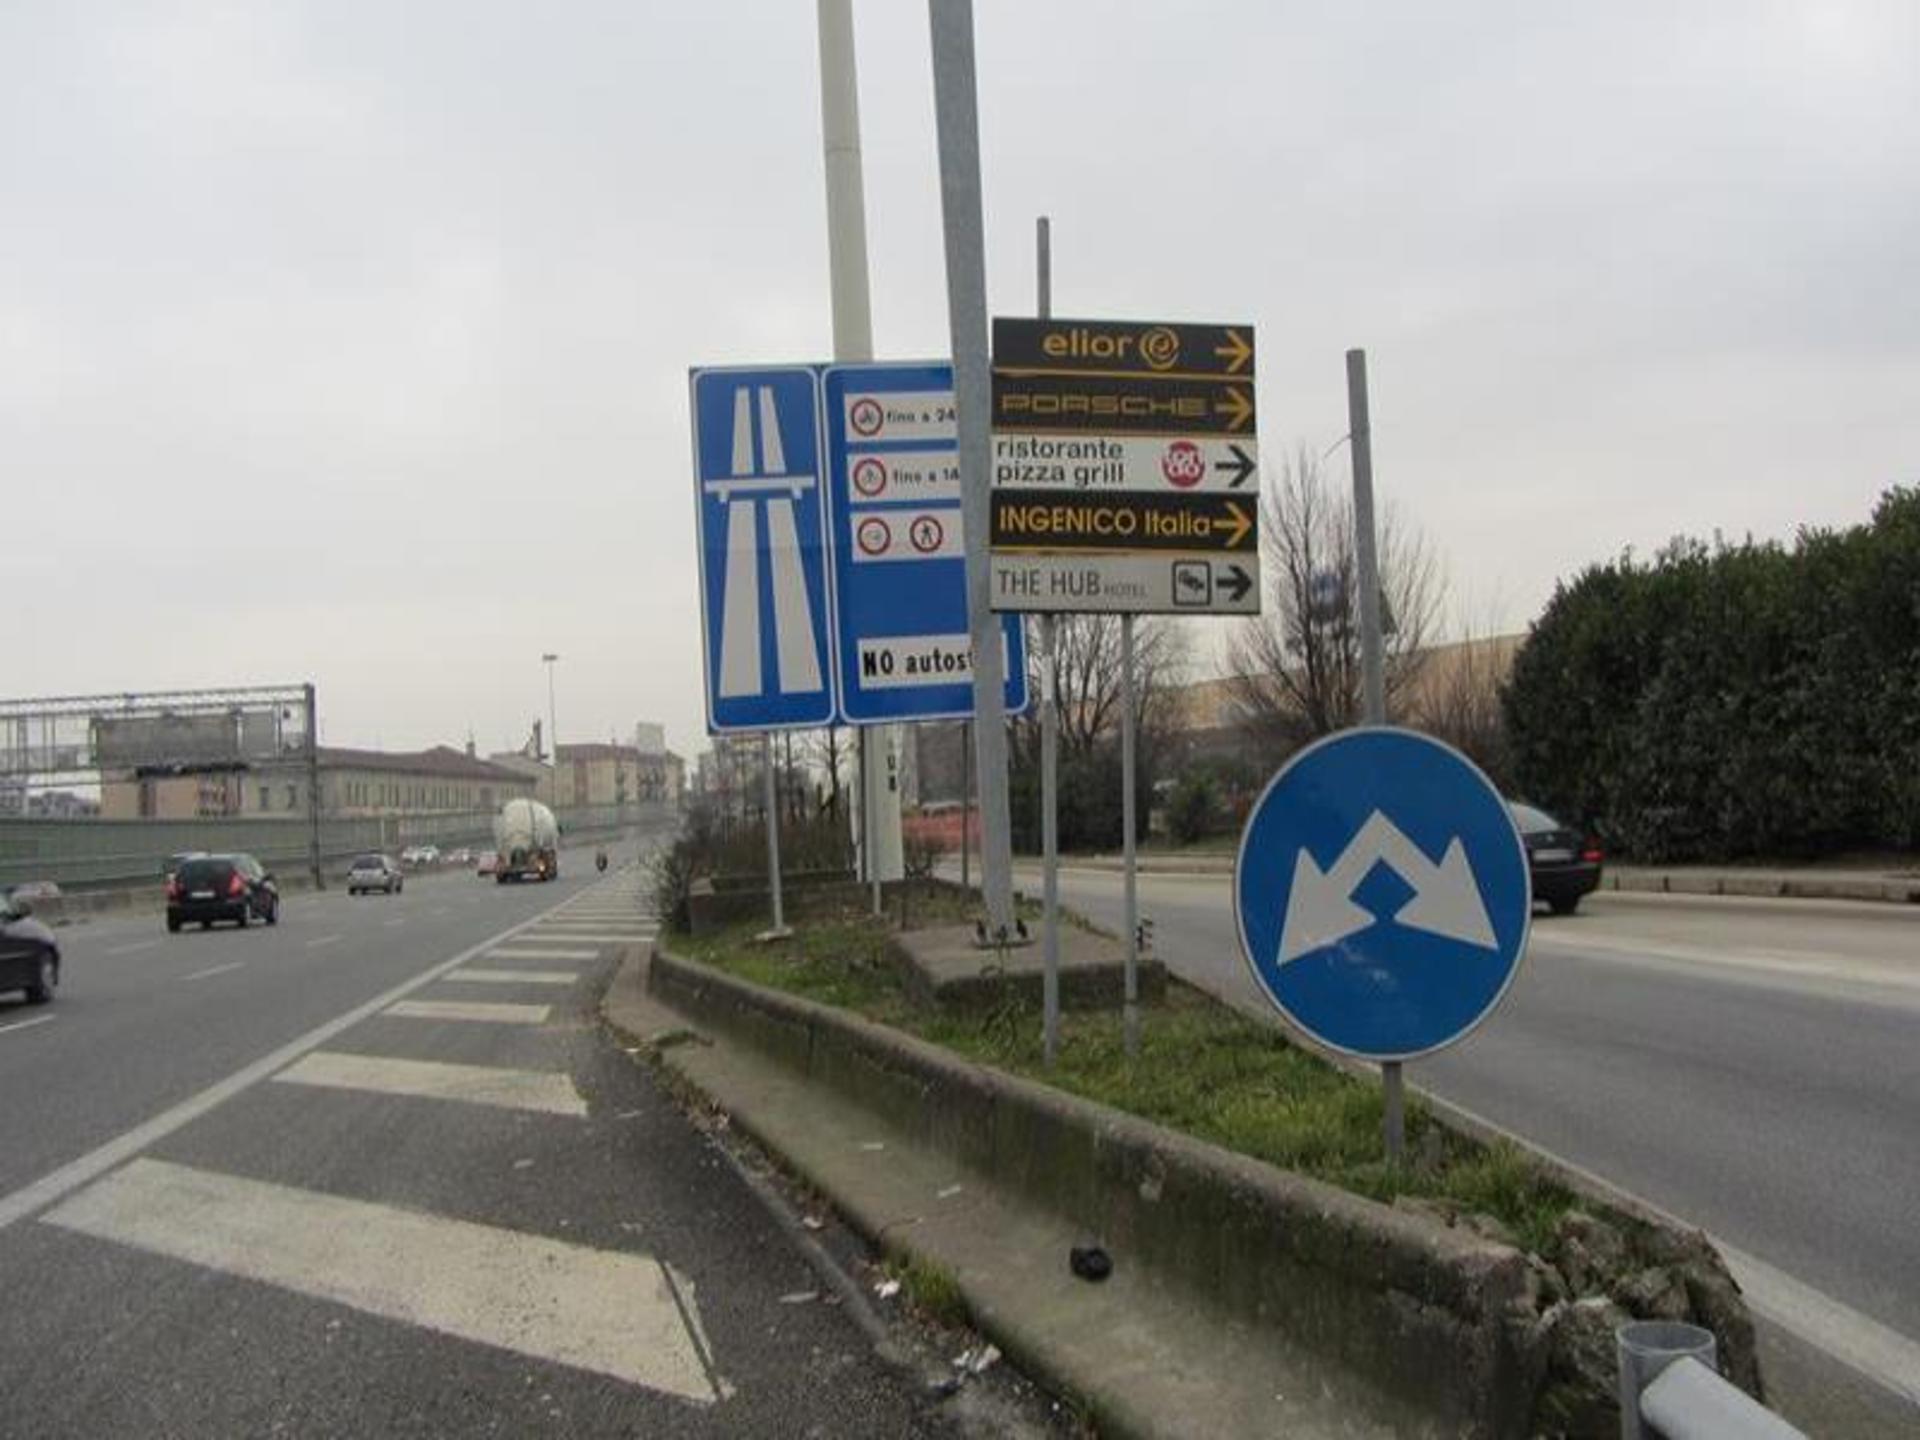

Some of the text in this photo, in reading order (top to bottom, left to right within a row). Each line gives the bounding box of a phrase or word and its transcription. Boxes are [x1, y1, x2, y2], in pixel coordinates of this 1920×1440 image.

[1043, 328, 1132, 358] elior
[1001, 394, 1206, 417] PORSCHE
[997, 435, 1123, 459] ristorante
[997, 461, 1124, 487] pizza grill
[1000, 506, 1211, 536] INGENICO Italia
[998, 569, 1147, 597] THE HUB HOTEL
[863, 647, 973, 676] NO autost
